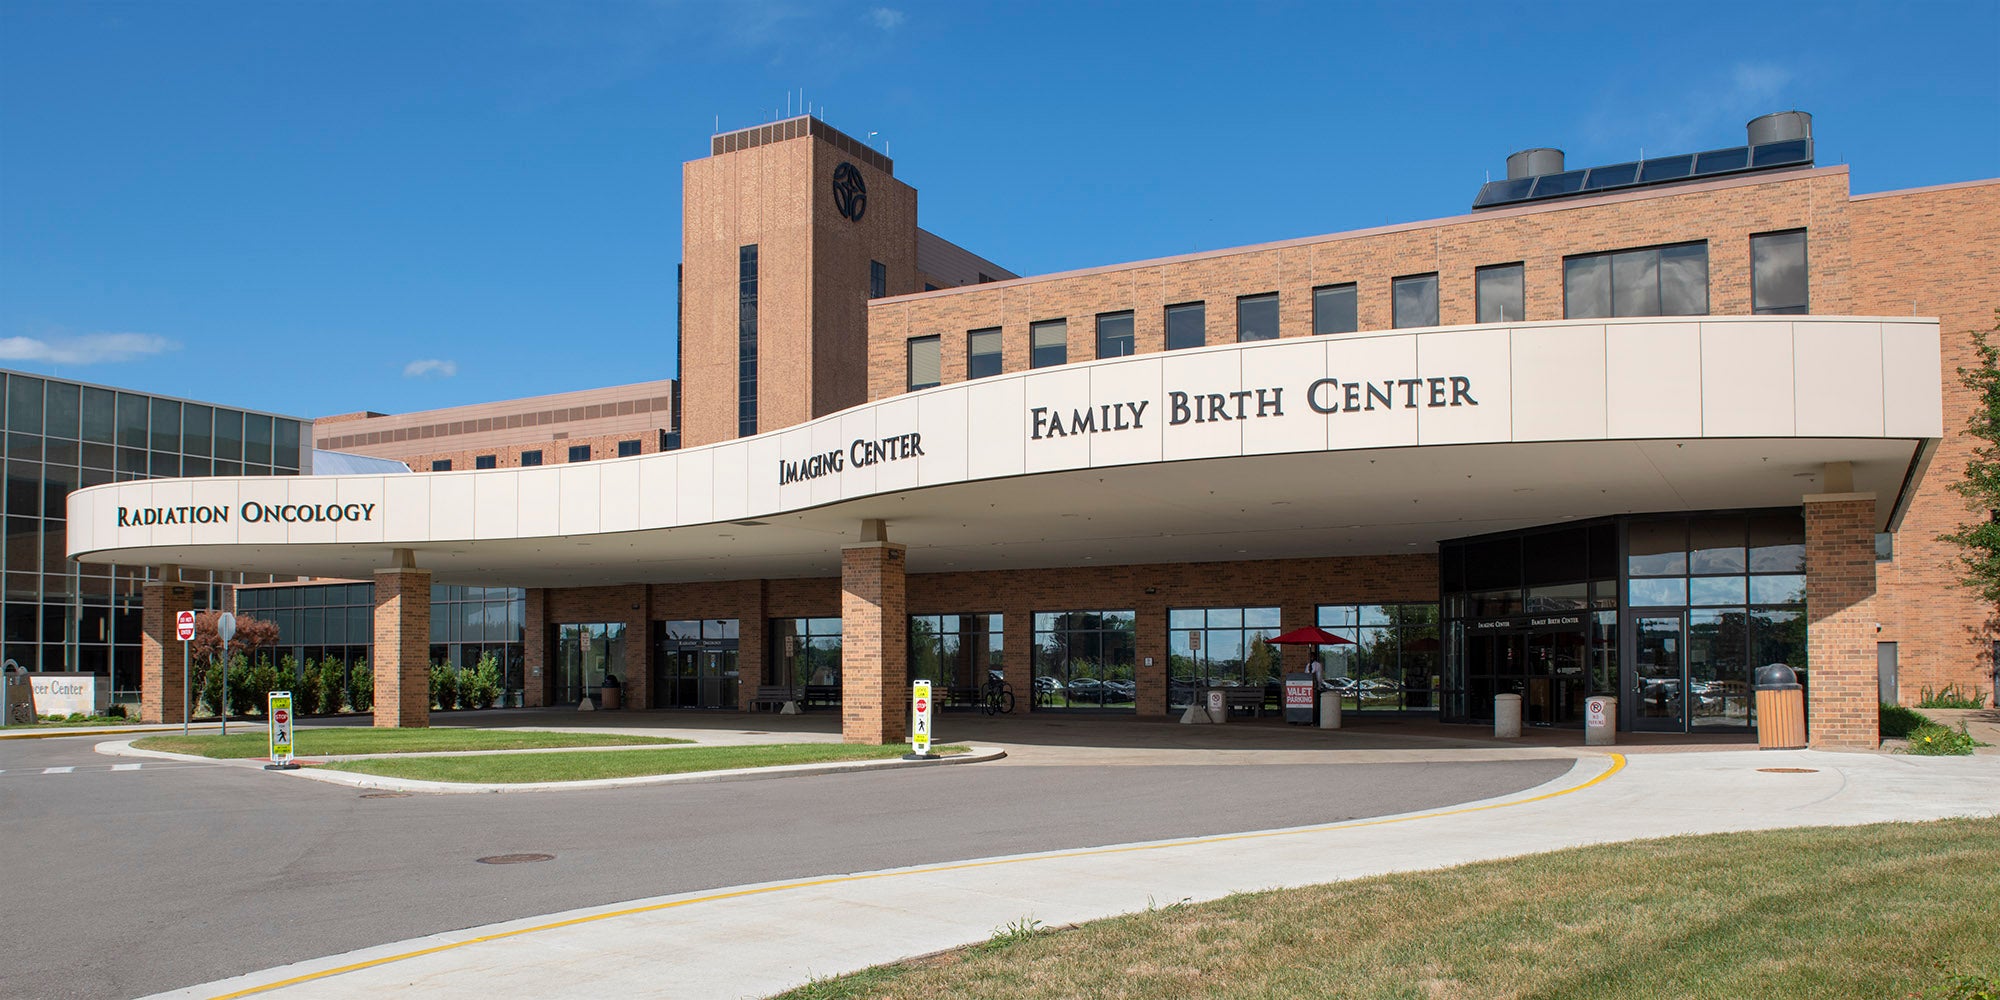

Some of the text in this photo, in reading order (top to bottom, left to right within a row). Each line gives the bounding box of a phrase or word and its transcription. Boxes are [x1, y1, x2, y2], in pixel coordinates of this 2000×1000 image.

[1030, 376, 1479, 440] FAMILY BIRTH CENTER
[779, 432, 925, 486] IMAGING CENTER
[118, 501, 376, 527] RADIATION ONCOLOGY
[33, 680, 83, 695] cer Center
[1287, 687, 1312, 696] VALET
